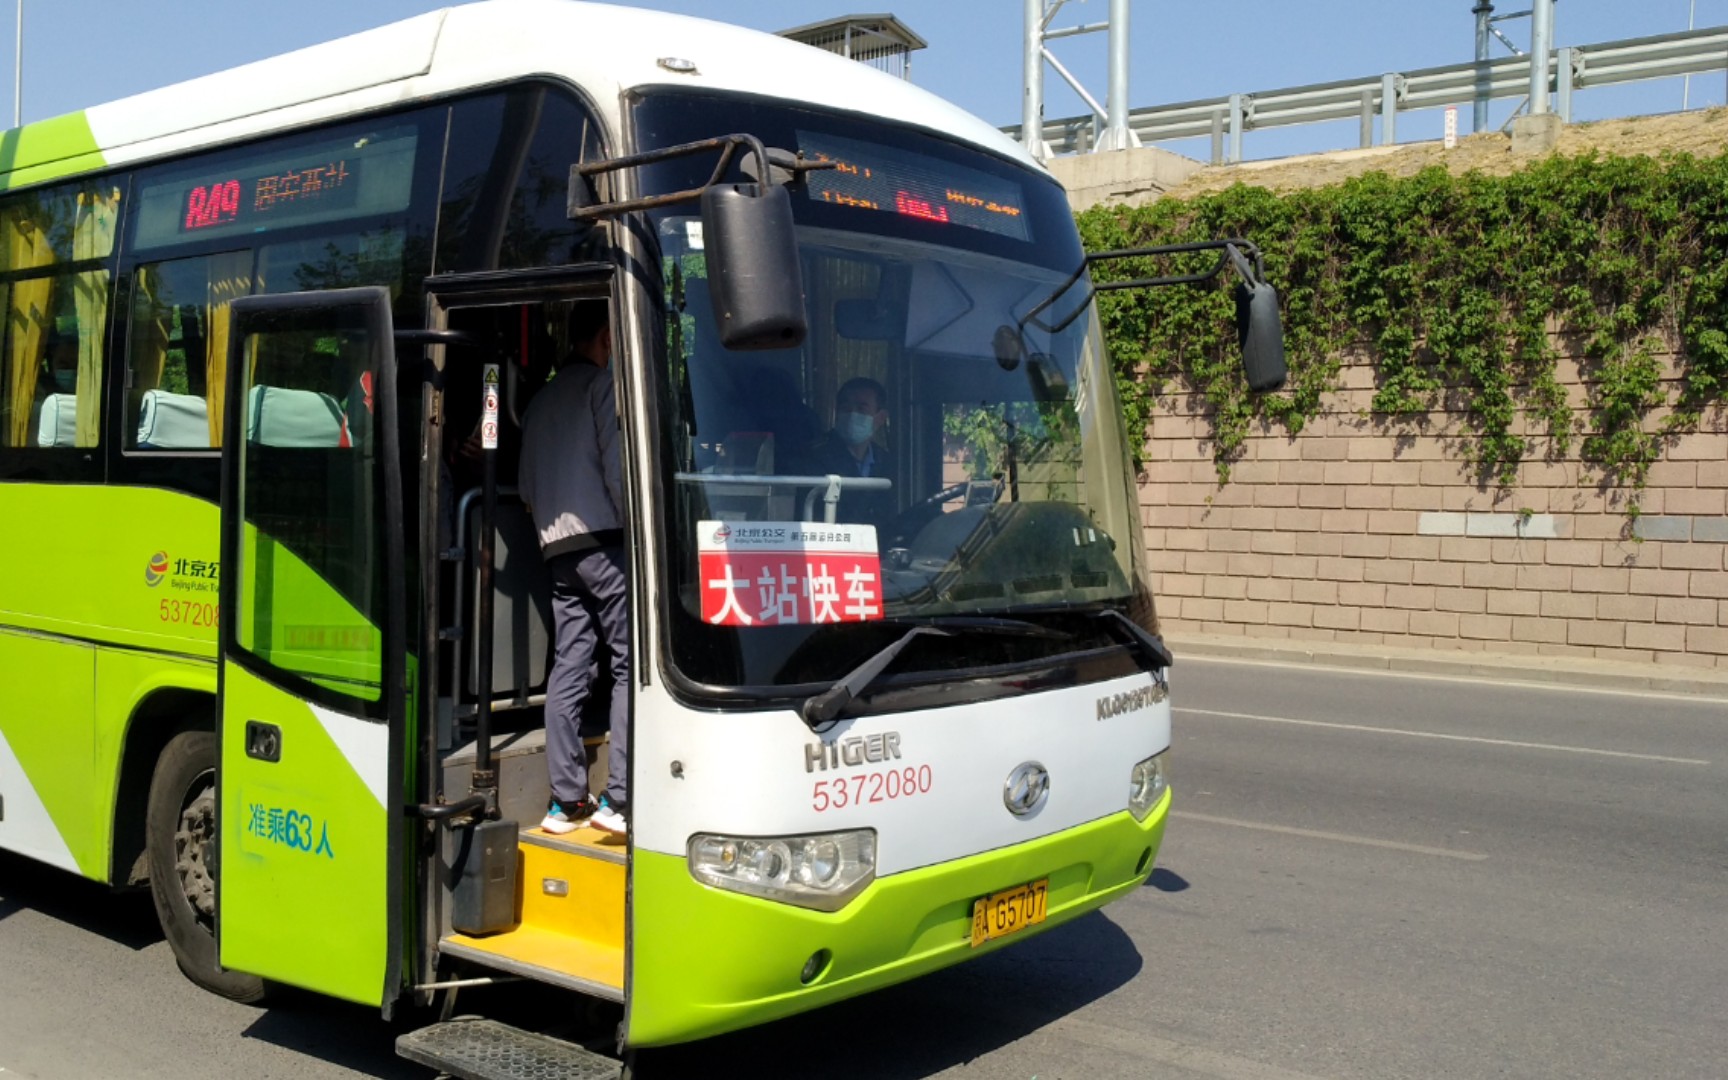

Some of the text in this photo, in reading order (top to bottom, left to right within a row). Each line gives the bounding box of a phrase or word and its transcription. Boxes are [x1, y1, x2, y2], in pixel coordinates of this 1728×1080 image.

[735, 528, 786, 538] 北京公交
[708, 563, 879, 625] 大站快车
[804, 731, 902, 773] HIGER
[812, 764, 932, 813] 5372080
[248, 803, 334, 859] 准乘63人
